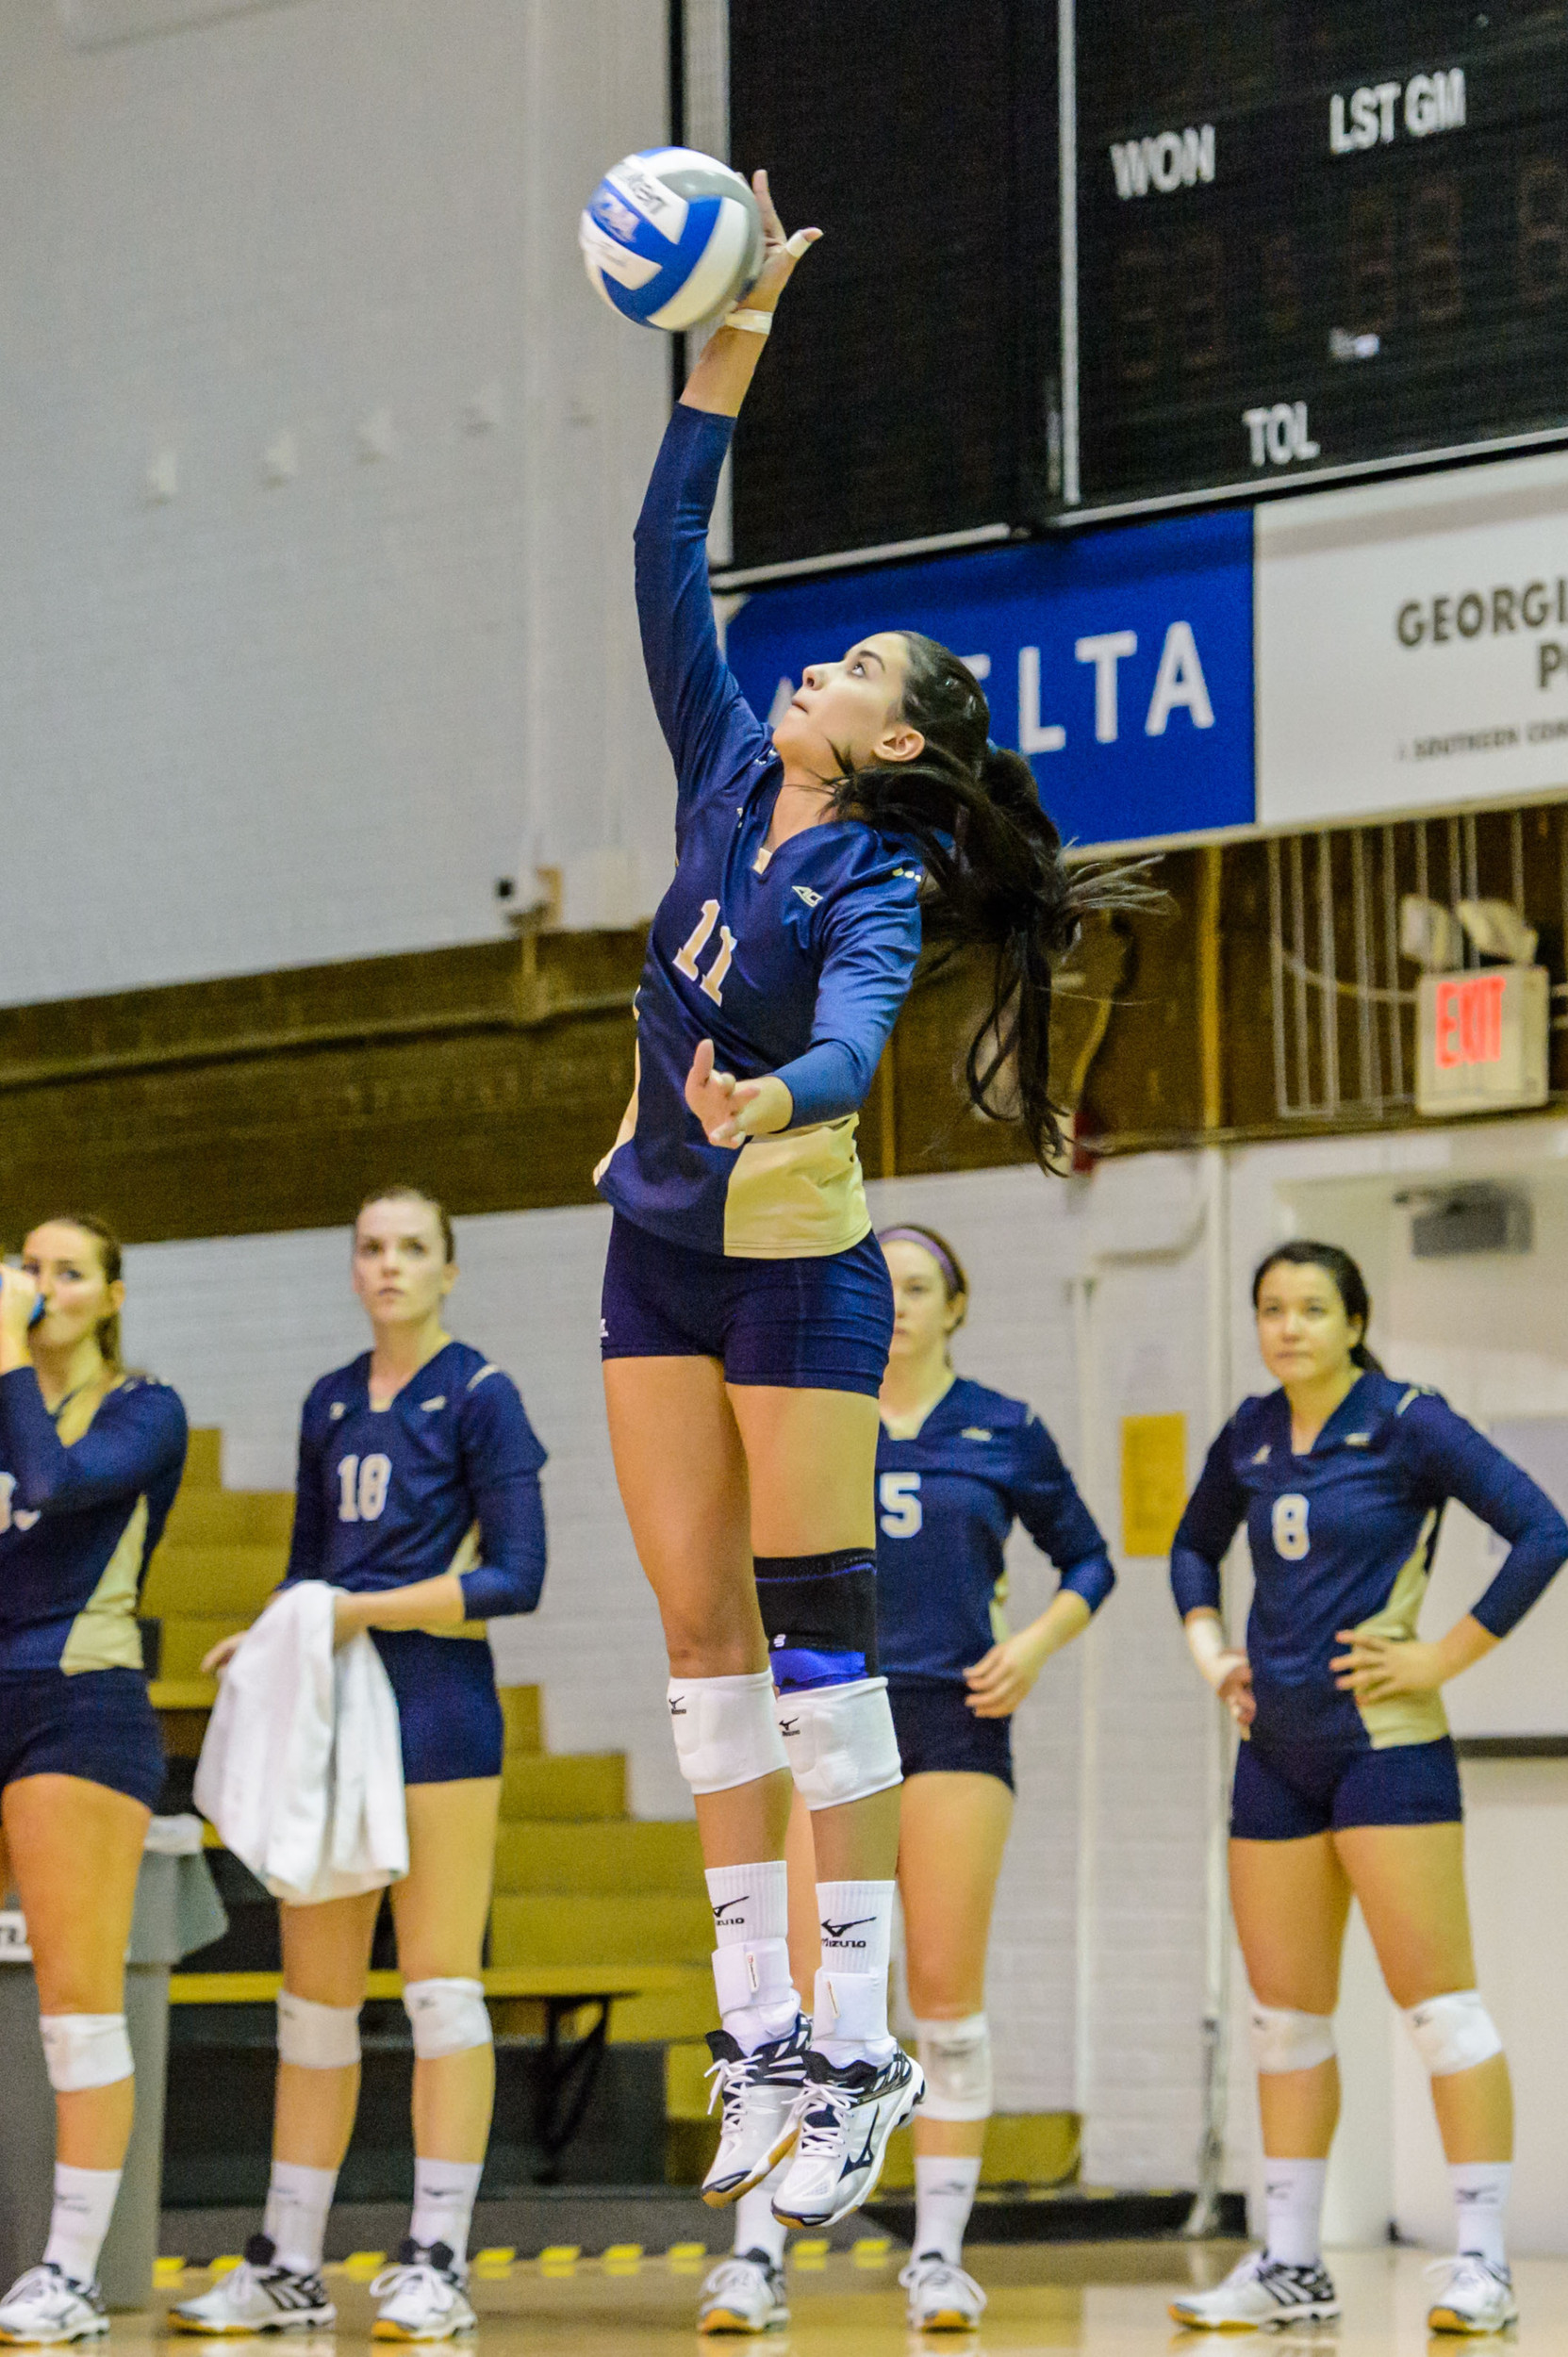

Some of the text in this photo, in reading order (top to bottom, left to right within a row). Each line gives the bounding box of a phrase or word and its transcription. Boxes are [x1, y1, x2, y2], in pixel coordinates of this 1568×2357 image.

[1329, 67, 1467, 155] LST GM
[1110, 124, 1216, 200] WON
[1243, 401, 1320, 467] TOL
[1396, 577, 1568, 647] GEORGI
[964, 620, 1216, 756] LTA
[672, 899, 737, 1007] 11
[1435, 975, 1507, 1069] EXIT
[337, 1453, 392, 1523] 18
[879, 1471, 923, 1540] 5
[1271, 1492, 1312, 1561] 8
